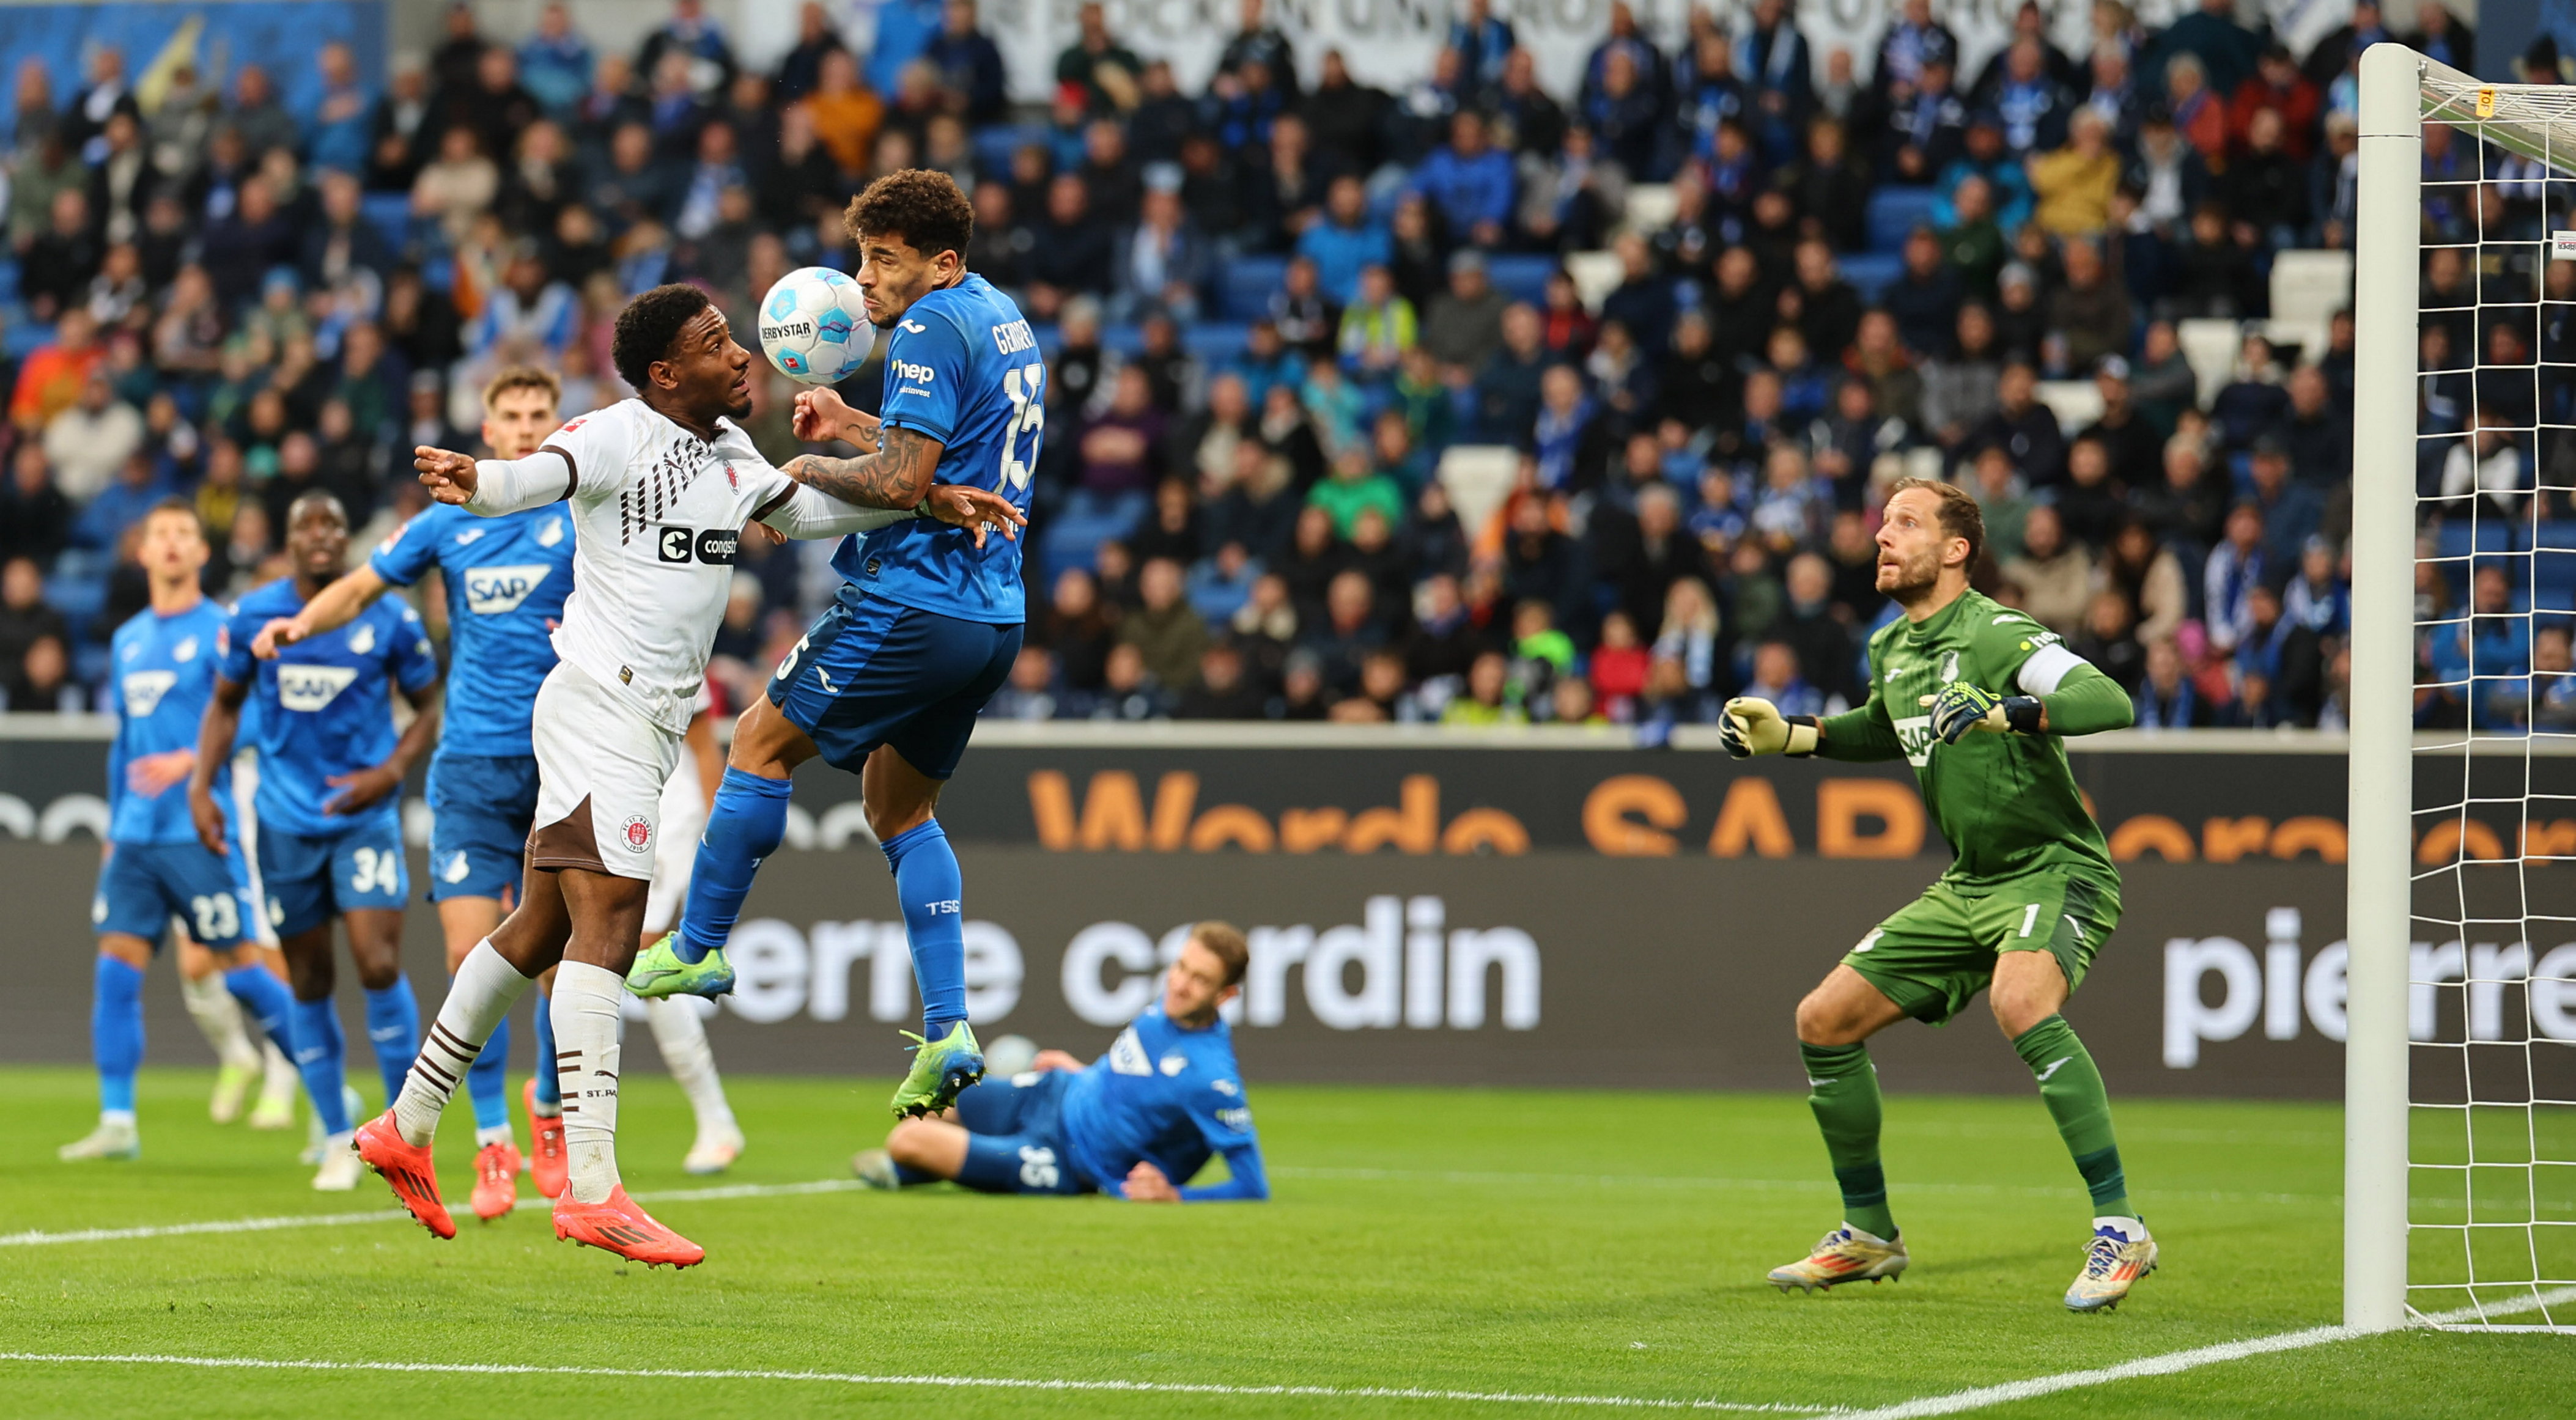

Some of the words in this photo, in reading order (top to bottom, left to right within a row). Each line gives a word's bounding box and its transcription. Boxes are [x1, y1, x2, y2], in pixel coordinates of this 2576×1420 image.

[2481, 90, 2491, 112] TOP
[762, 322, 811, 339] DERBYSTAR
[898, 359, 934, 384] hep
[992, 363, 1044, 495] 15
[470, 578, 528, 601] SAP
[1899, 726, 1931, 757] SAP
[351, 847, 398, 896] 34
[191, 893, 240, 940] 23
[925, 900, 960, 916] TSG
[2018, 903, 2040, 938] 1
[619, 917, 1025, 1041] erre
